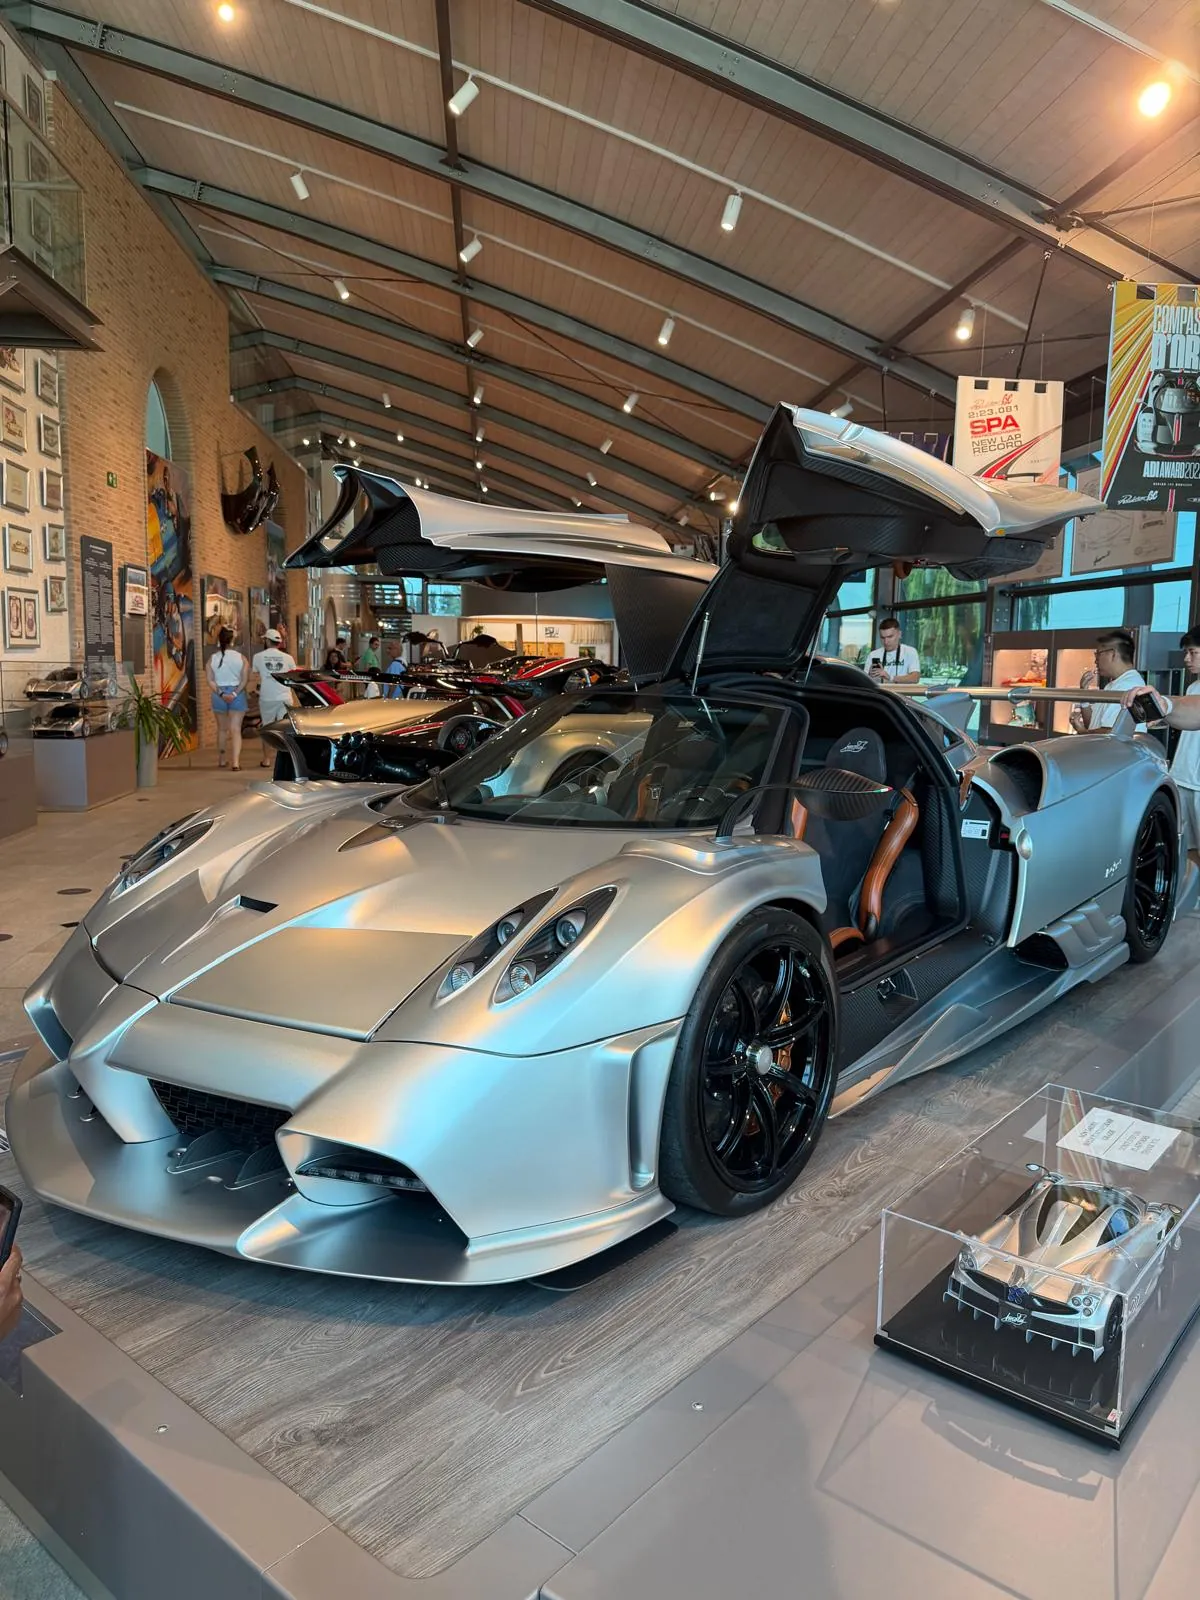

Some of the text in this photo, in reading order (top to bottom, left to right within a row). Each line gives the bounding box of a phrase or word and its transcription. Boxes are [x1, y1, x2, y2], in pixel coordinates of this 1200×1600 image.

[969, 414, 1020, 435] SPA
[971, 433, 1022, 448] NEW LAP
[972, 440, 1023, 455] RECORD
[1184, 462, 1200, 480] 202
